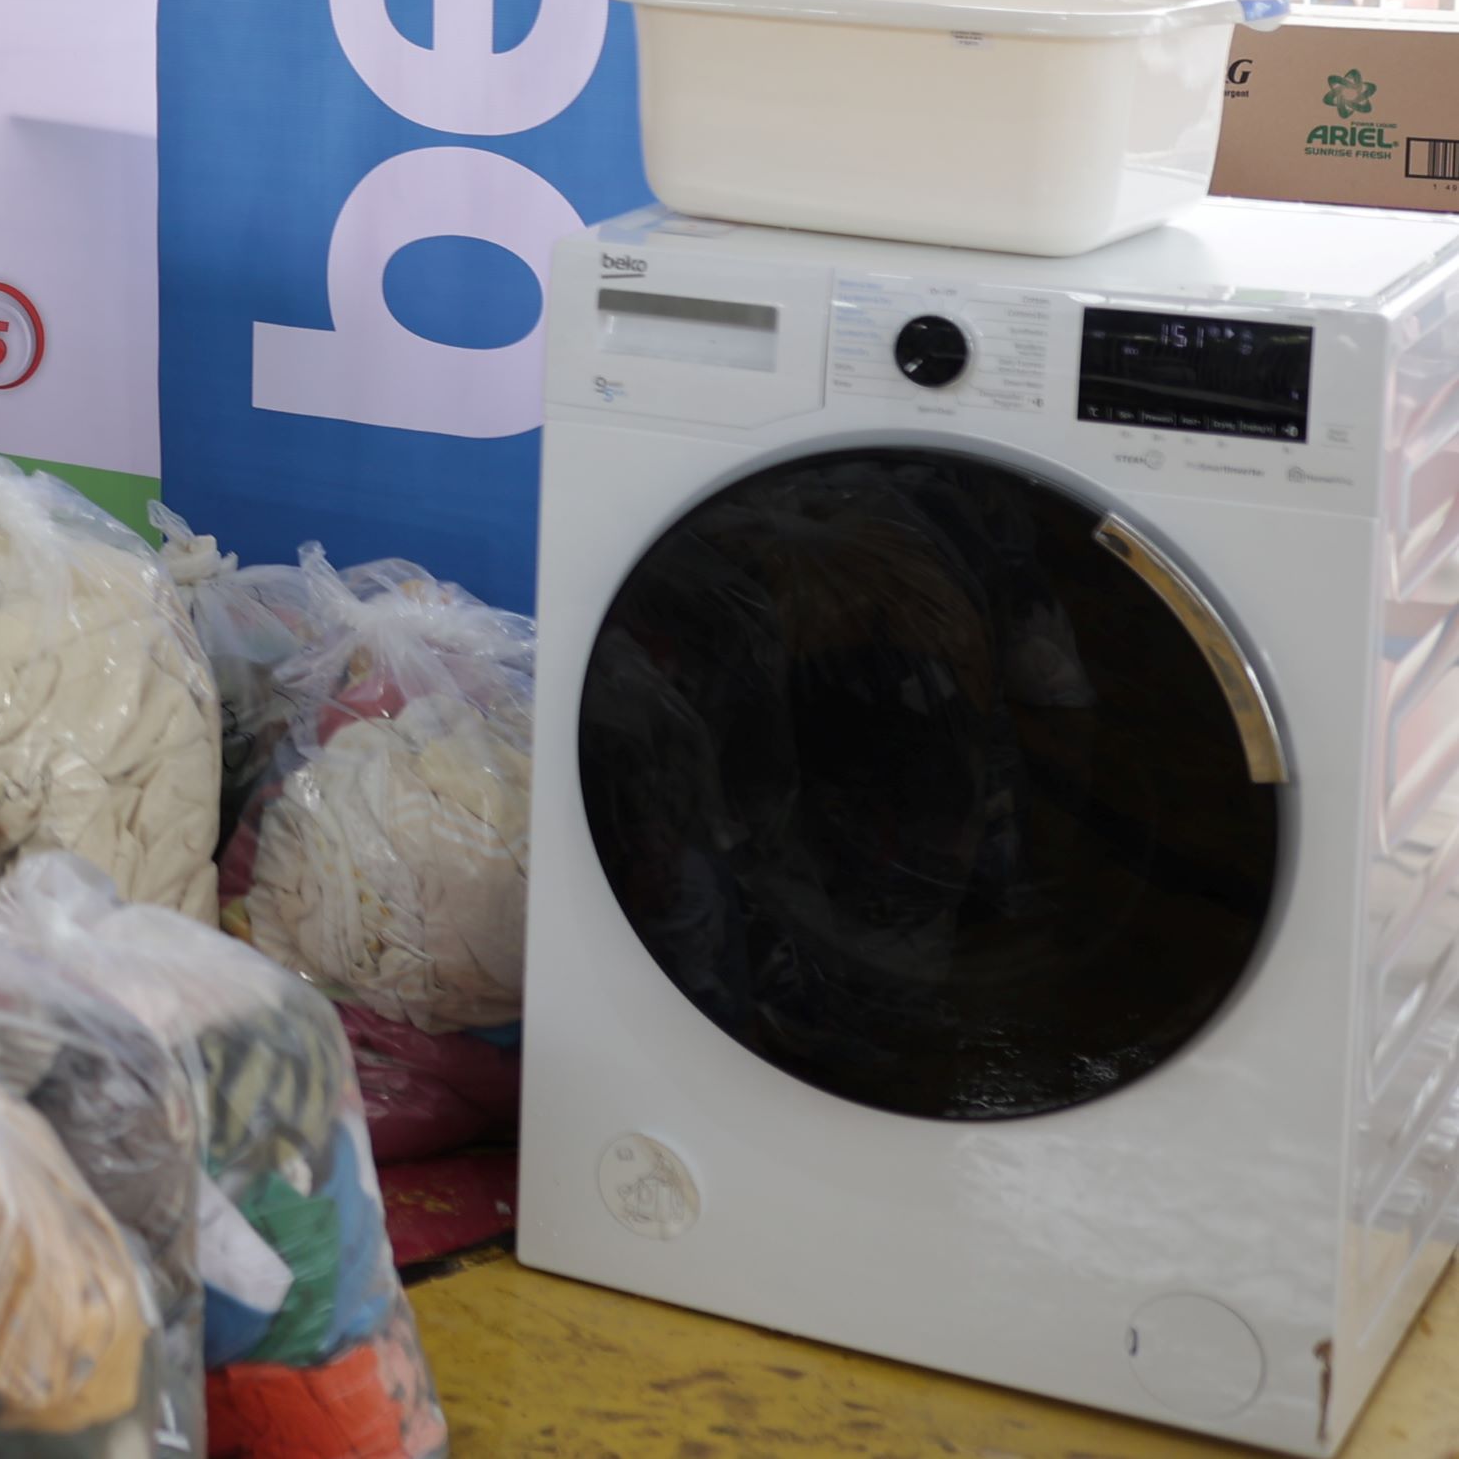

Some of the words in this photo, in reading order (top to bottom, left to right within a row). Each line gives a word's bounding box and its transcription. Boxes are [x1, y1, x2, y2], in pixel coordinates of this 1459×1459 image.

[1306, 125, 1394, 149] ARIEL
[1304, 147, 1353, 158] SUNRISE
[1356, 150, 1392, 160] FRESH
